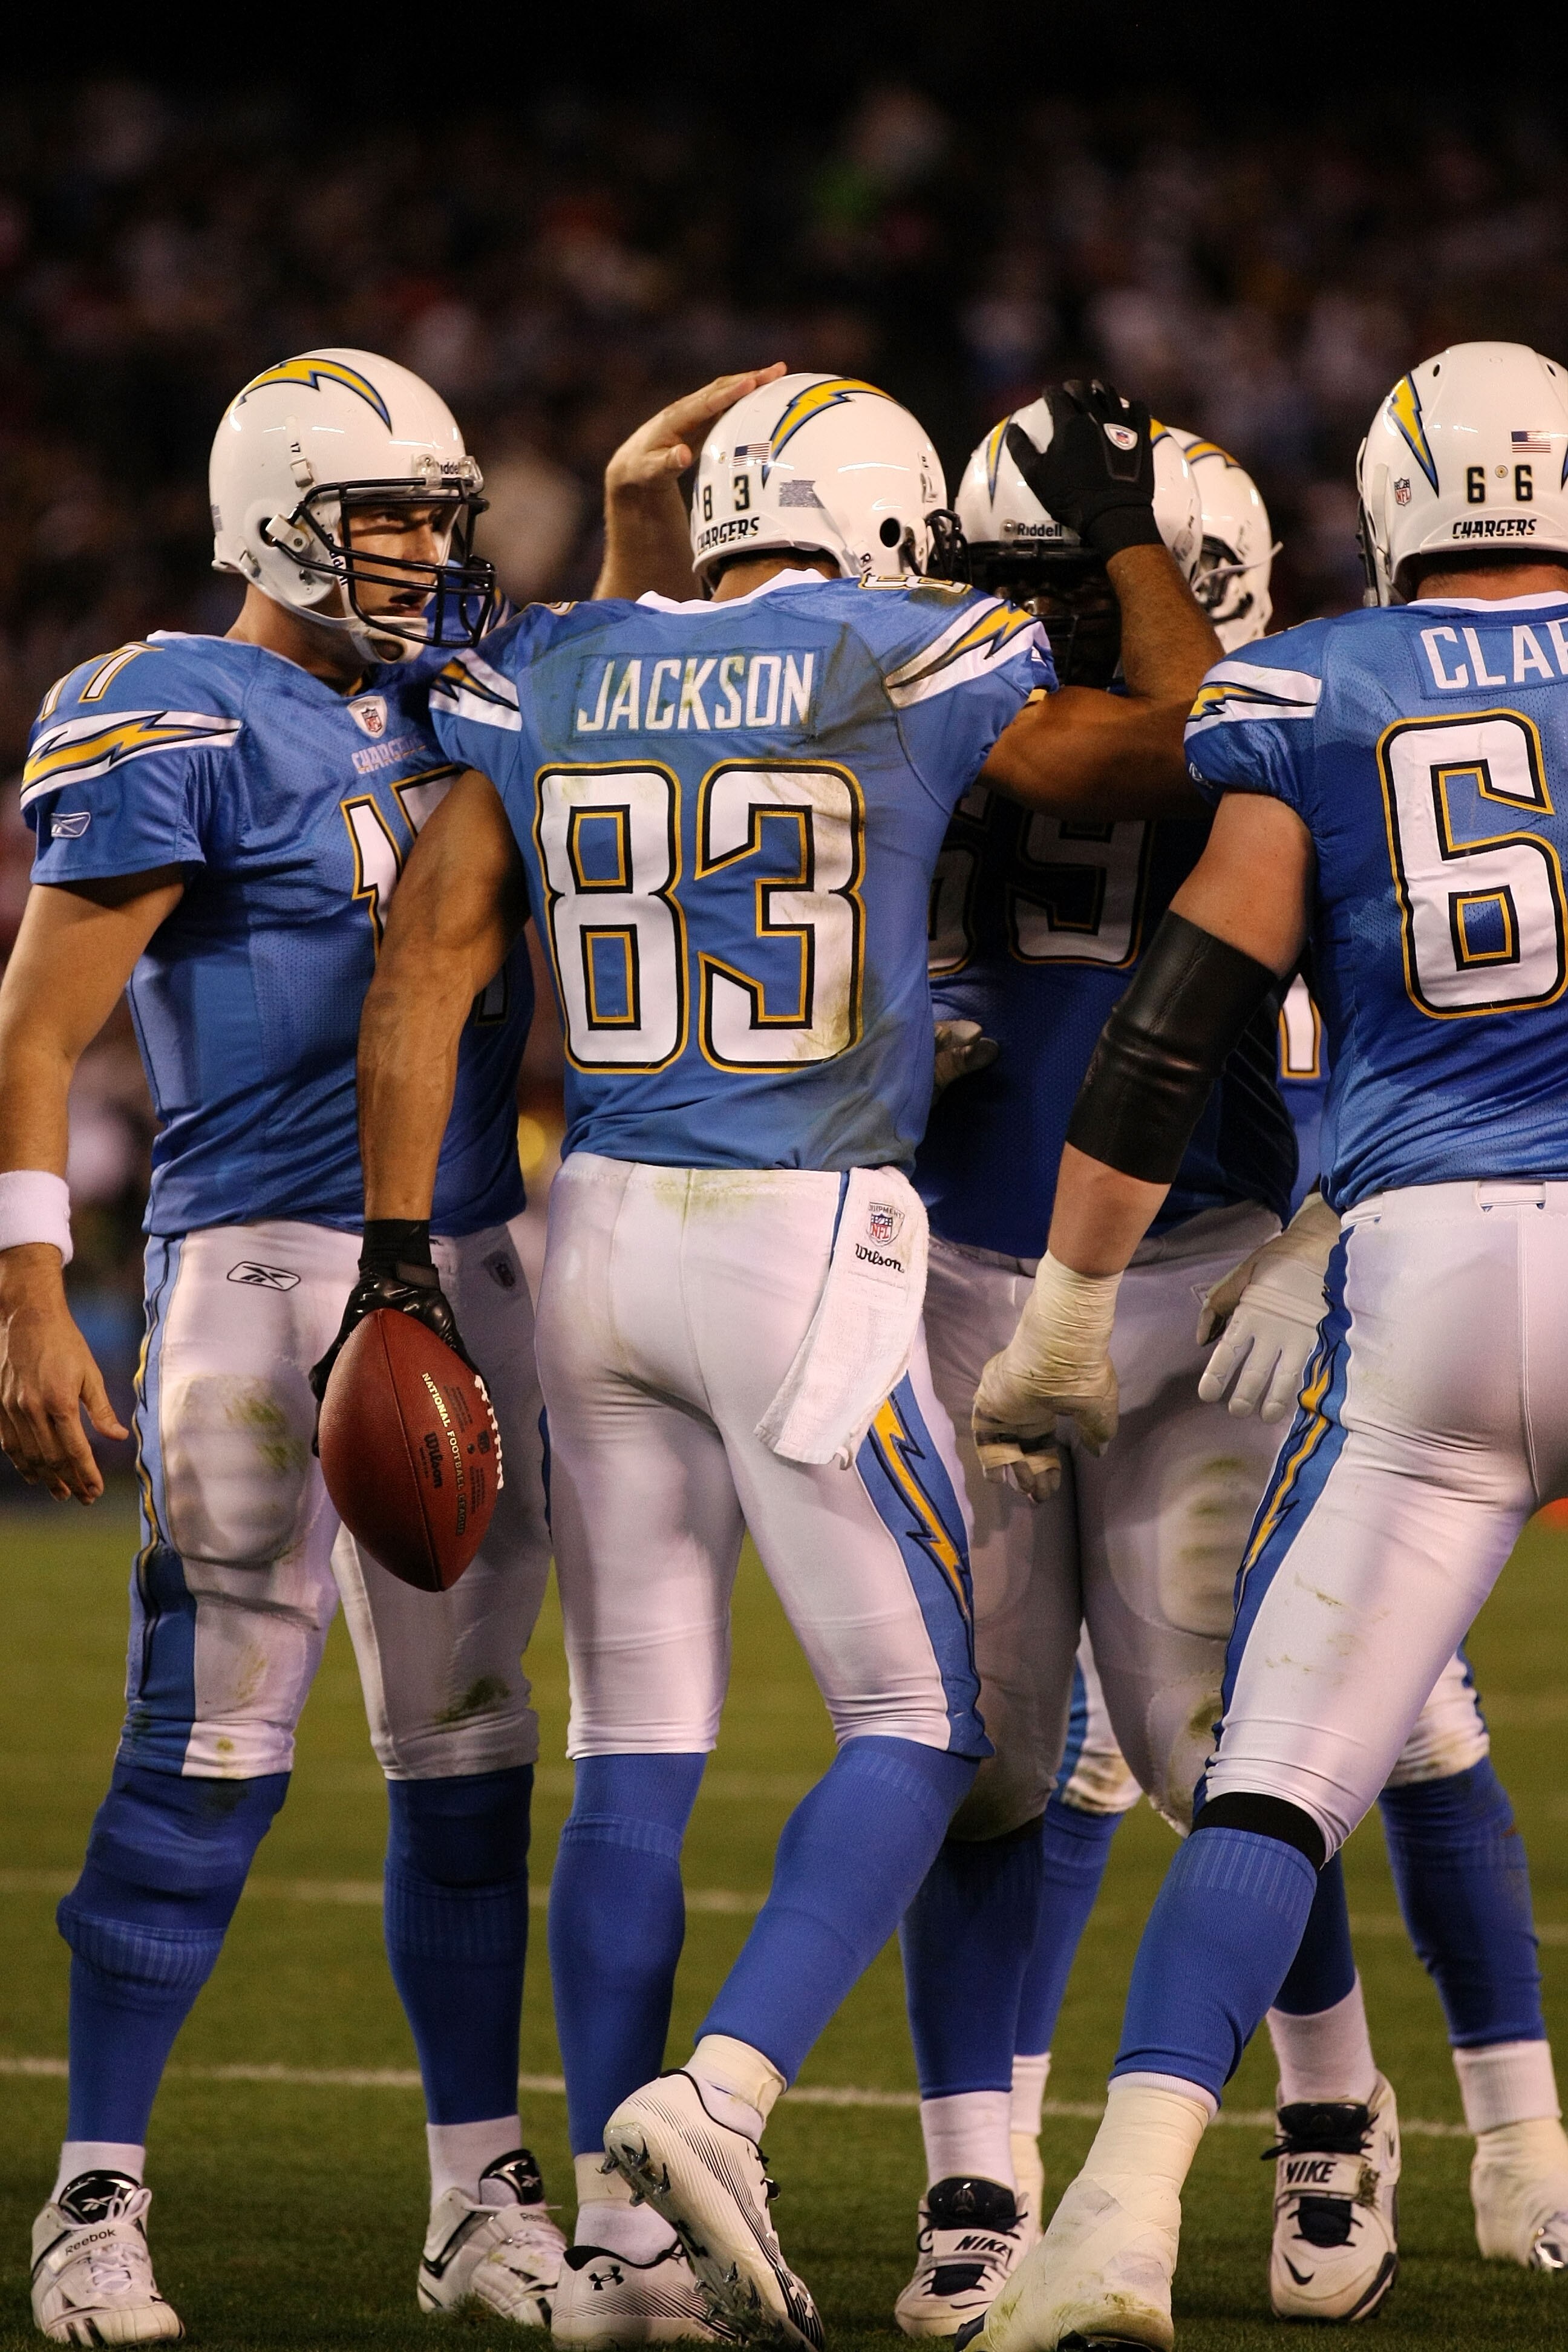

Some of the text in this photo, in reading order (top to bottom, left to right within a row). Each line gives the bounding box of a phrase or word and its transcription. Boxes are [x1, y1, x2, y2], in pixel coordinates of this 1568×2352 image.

[1395, 491, 1411, 508] NFL
[1016, 522, 1063, 537] Riddell
[1452, 518, 1537, 539] CHARGERS
[577, 653, 815, 733] JACKSON
[1376, 707, 1568, 1020] 6
[531, 759, 867, 1076] 83
[871, 1223, 889, 1240] NFL
[855, 1243, 901, 1273] Wilson
[422, 1372, 451, 1428] NATIONAL
[446, 1430, 465, 1491] FOOTBALL
[423, 1431, 443, 1489] Wilson
[1286, 2160, 1338, 2184] NIKE
[65, 2229, 116, 2256] Reebok
